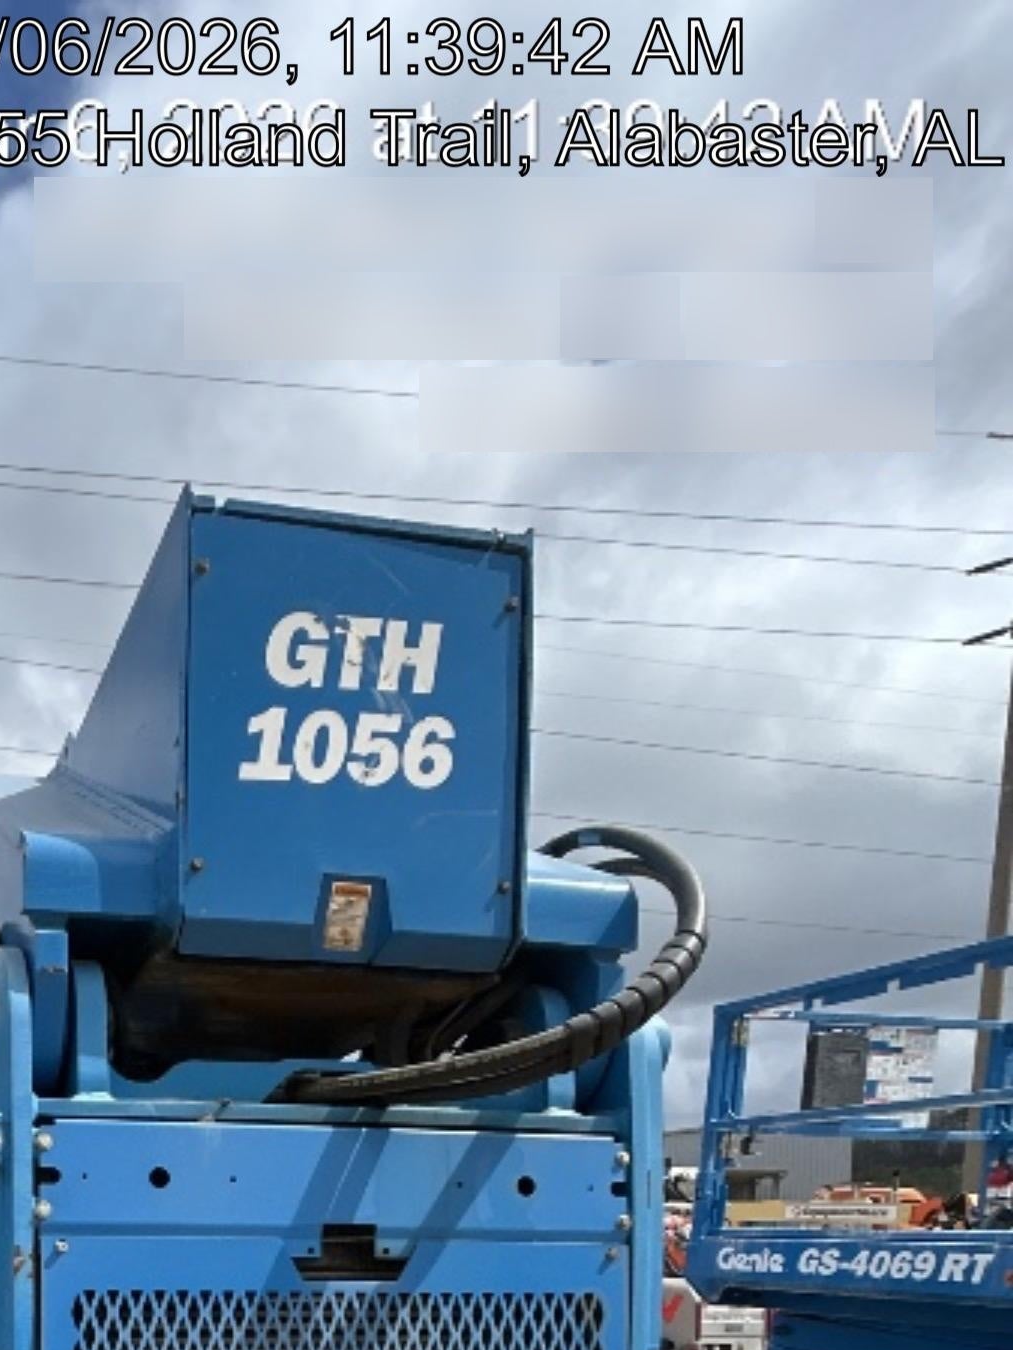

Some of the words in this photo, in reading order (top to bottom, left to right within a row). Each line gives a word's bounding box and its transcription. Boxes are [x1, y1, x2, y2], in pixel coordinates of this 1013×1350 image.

[265, 611, 444, 694] GTH
[238, 706, 457, 790] 1056
[716, 1246, 786, 1273] Genie
[797, 1247, 936, 1282] GS-4069
[937, 1252, 996, 1285] RT
